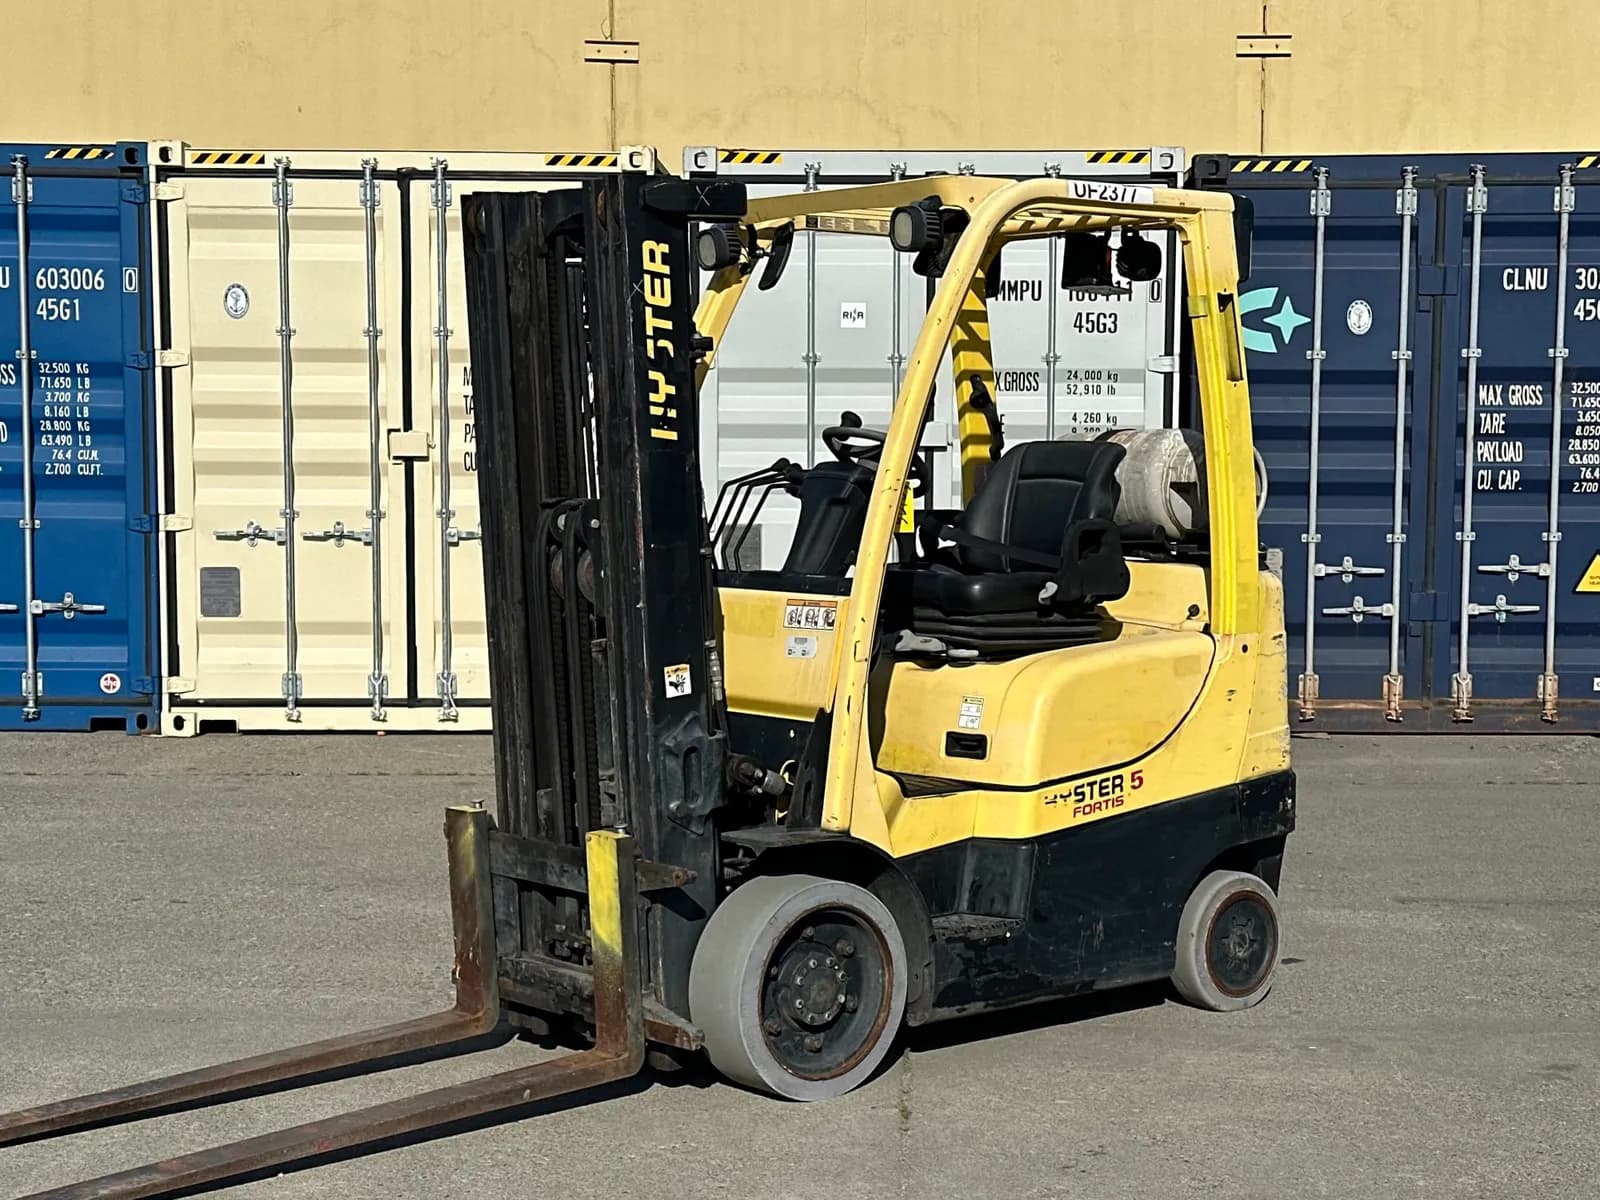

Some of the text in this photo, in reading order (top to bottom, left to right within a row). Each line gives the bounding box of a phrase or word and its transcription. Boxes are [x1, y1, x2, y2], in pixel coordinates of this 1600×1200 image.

[36, 267, 105, 291] 603006
[1503, 268, 1549, 290] CLNU
[36, 298, 80, 321] 45G1
[1073, 312, 1118, 334] 45G3
[39, 363, 89, 374] 32.500 KG
[40, 377, 90, 389] 71.650 LB
[995, 371, 1039, 392] X.GROSS
[1066, 370, 1118, 383] 24,000 kg
[45, 392, 89, 402] 3.700 KG
[1066, 384, 1116, 396] 52,910 lb
[1479, 385, 1543, 406] MAX GROSS
[44, 406, 89, 417] 8.160 LB
[40, 421, 90, 431] 28.800 KG
[1072, 412, 1117, 427] 4,260 kg
[1480, 413, 1506, 434] TARE
[41, 435, 91, 446] 63.490 LB
[52, 449, 71, 460] 76.4
[1477, 441, 1523, 462] PAYLOAD
[45, 463, 71, 475] 2.700
[1580, 467, 1600, 479] 76.4
[1478, 470, 1522, 490] CU. CAP.
[1572, 482, 1599, 493] 2.700
[1130, 769, 1144, 790] 5
[1073, 795, 1125, 818] FORTIS
